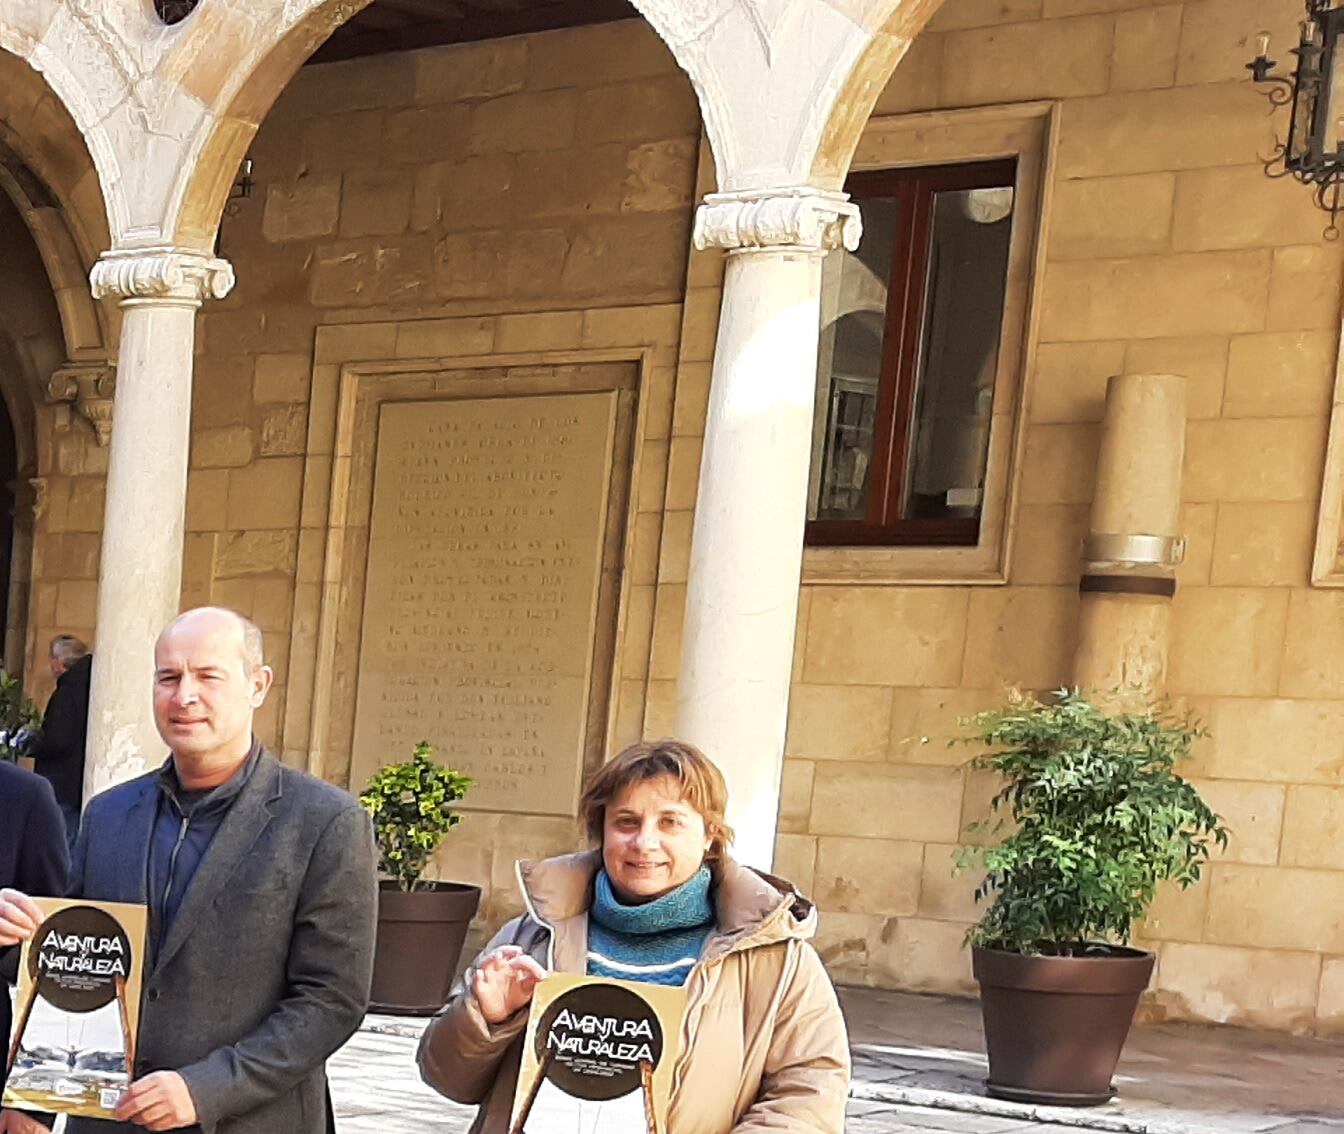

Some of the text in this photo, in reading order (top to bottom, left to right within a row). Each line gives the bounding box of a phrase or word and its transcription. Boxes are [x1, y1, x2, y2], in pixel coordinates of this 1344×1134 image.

[41, 930, 123, 955] AVENTURA
[38, 951, 125, 976] NATURALEZA
[552, 1008, 653, 1040] AVENTURA
[546, 1030, 654, 1063] NATURALEZA
